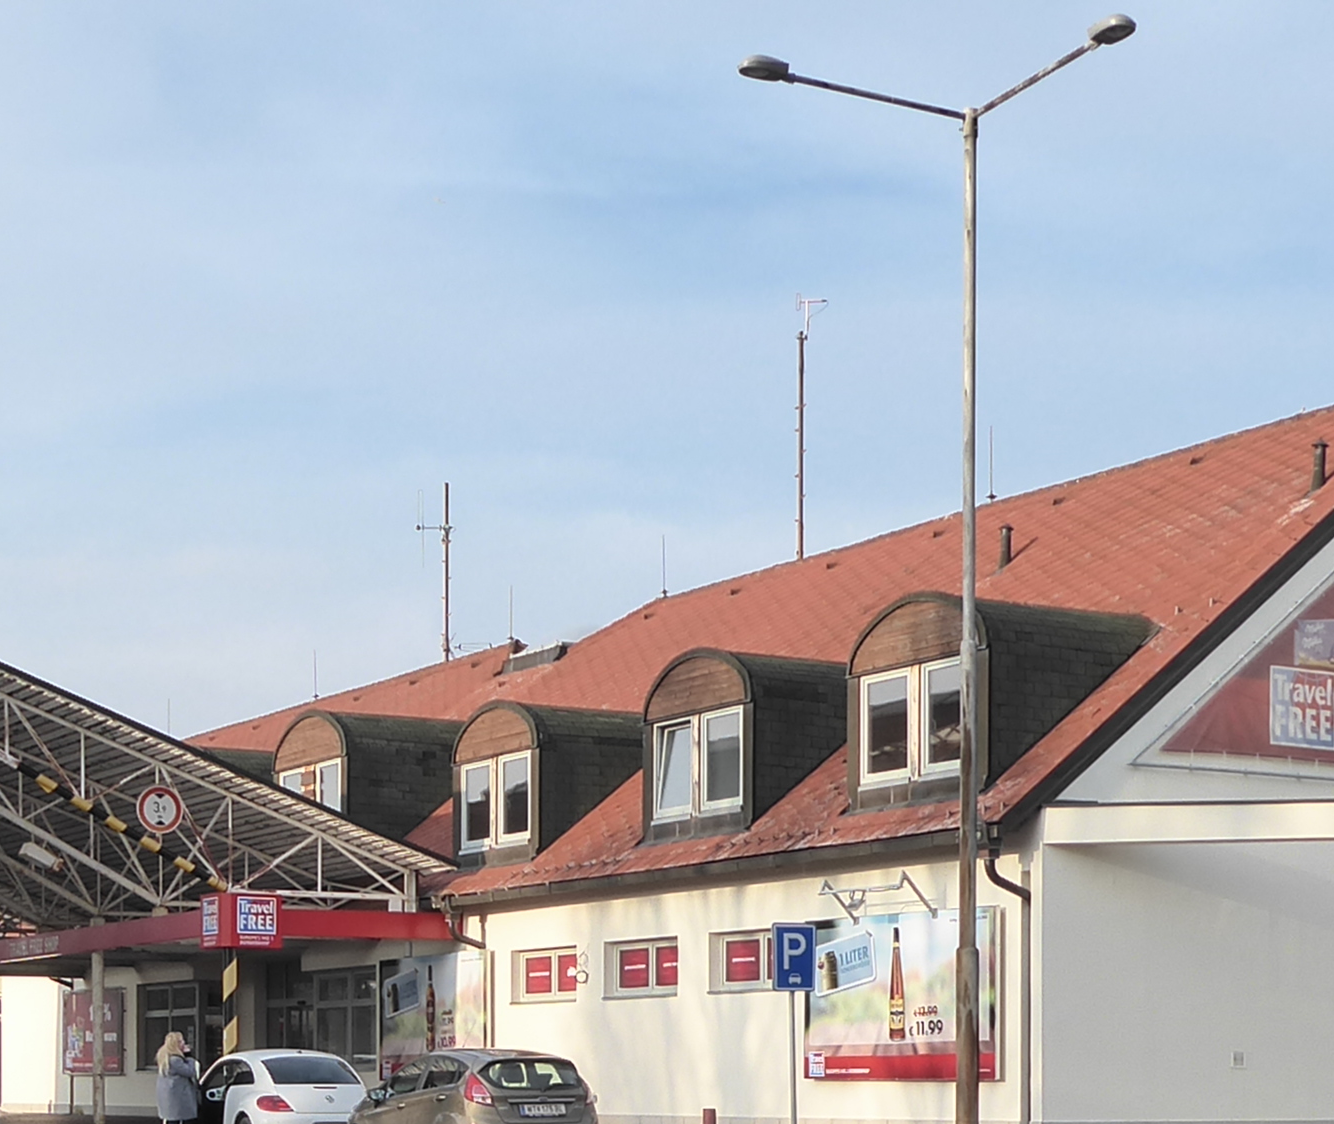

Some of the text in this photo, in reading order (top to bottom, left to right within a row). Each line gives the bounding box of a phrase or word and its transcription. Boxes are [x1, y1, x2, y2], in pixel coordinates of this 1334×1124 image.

[1273, 673, 1333, 707] Travel
[1274, 703, 1333, 742] FREE
[239, 900, 274, 914] Travel
[240, 914, 274, 931] FREE
[783, 932, 807, 970] P
[845, 945, 870, 965] LITER
